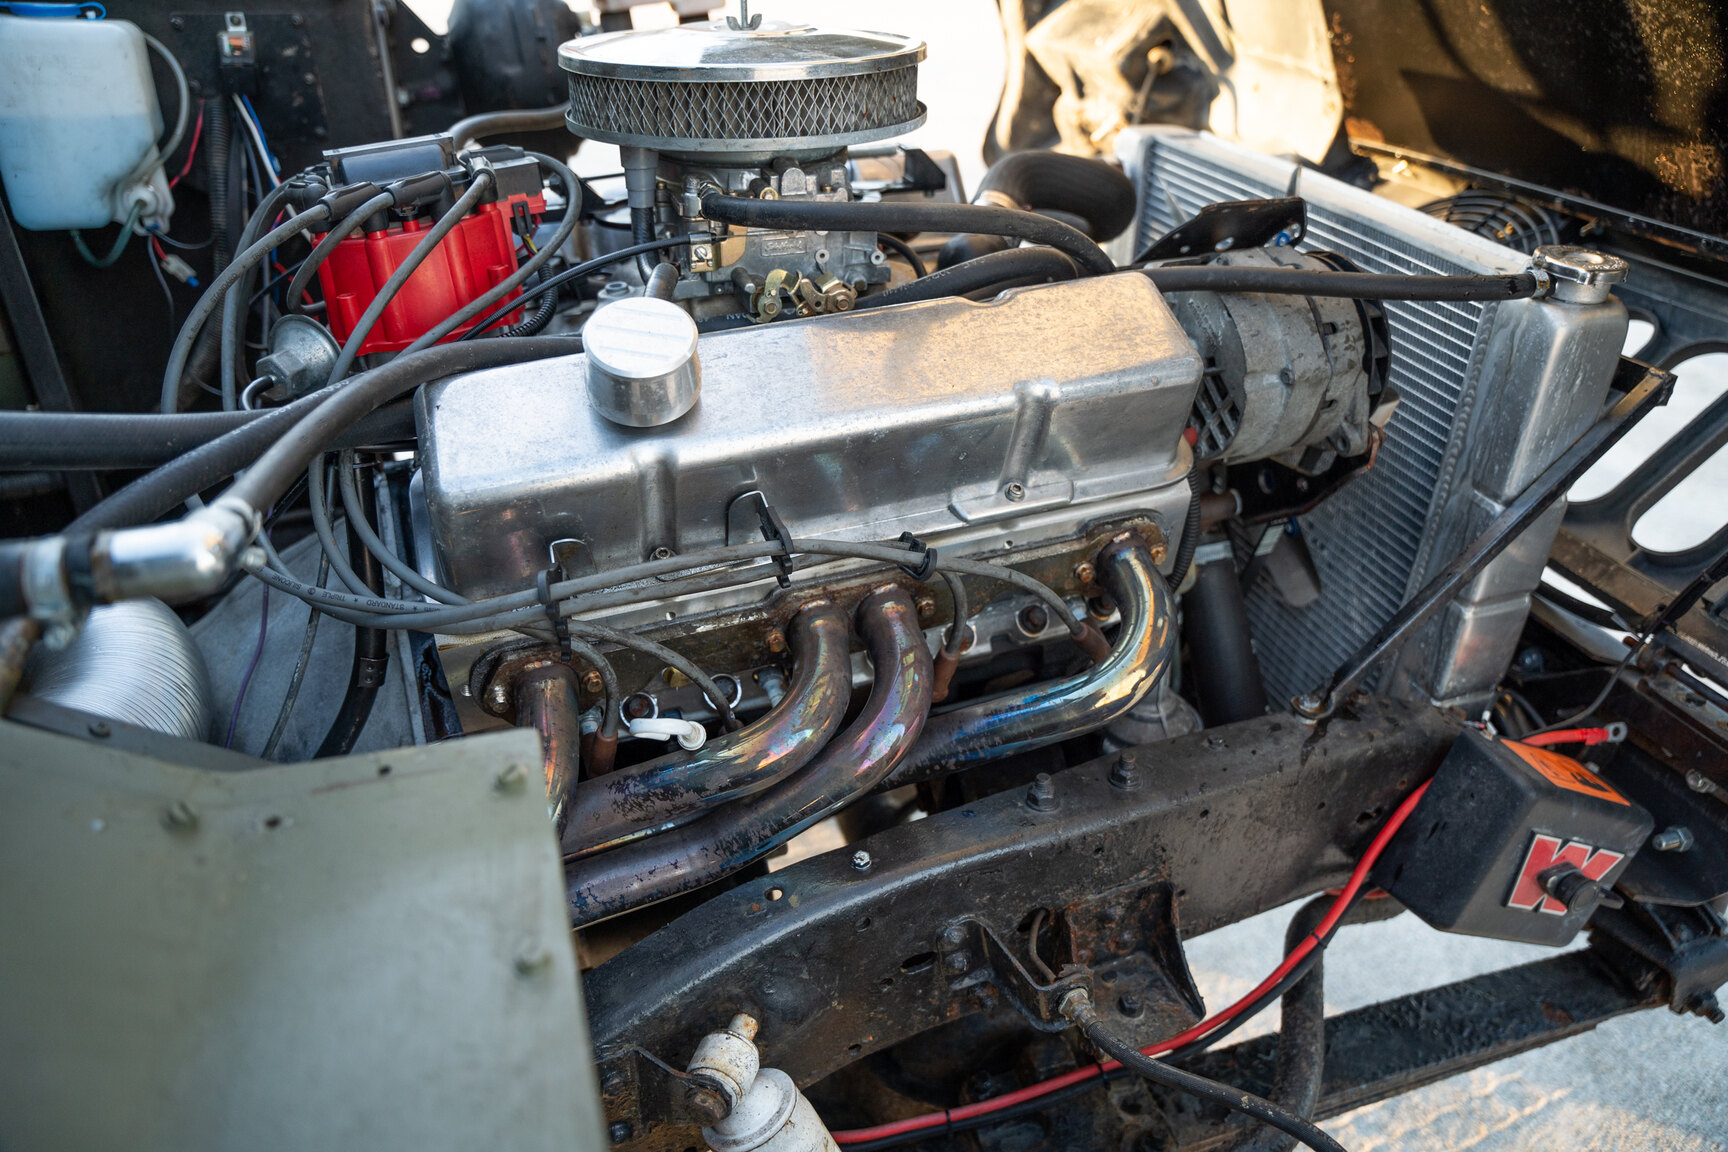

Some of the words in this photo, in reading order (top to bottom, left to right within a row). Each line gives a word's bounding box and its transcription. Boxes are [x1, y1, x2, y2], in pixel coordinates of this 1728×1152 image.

[271, 573, 303, 591] SILICONE
[321, 590, 346, 602] TRIPLE
[366, 599, 406, 612] STANDARD
